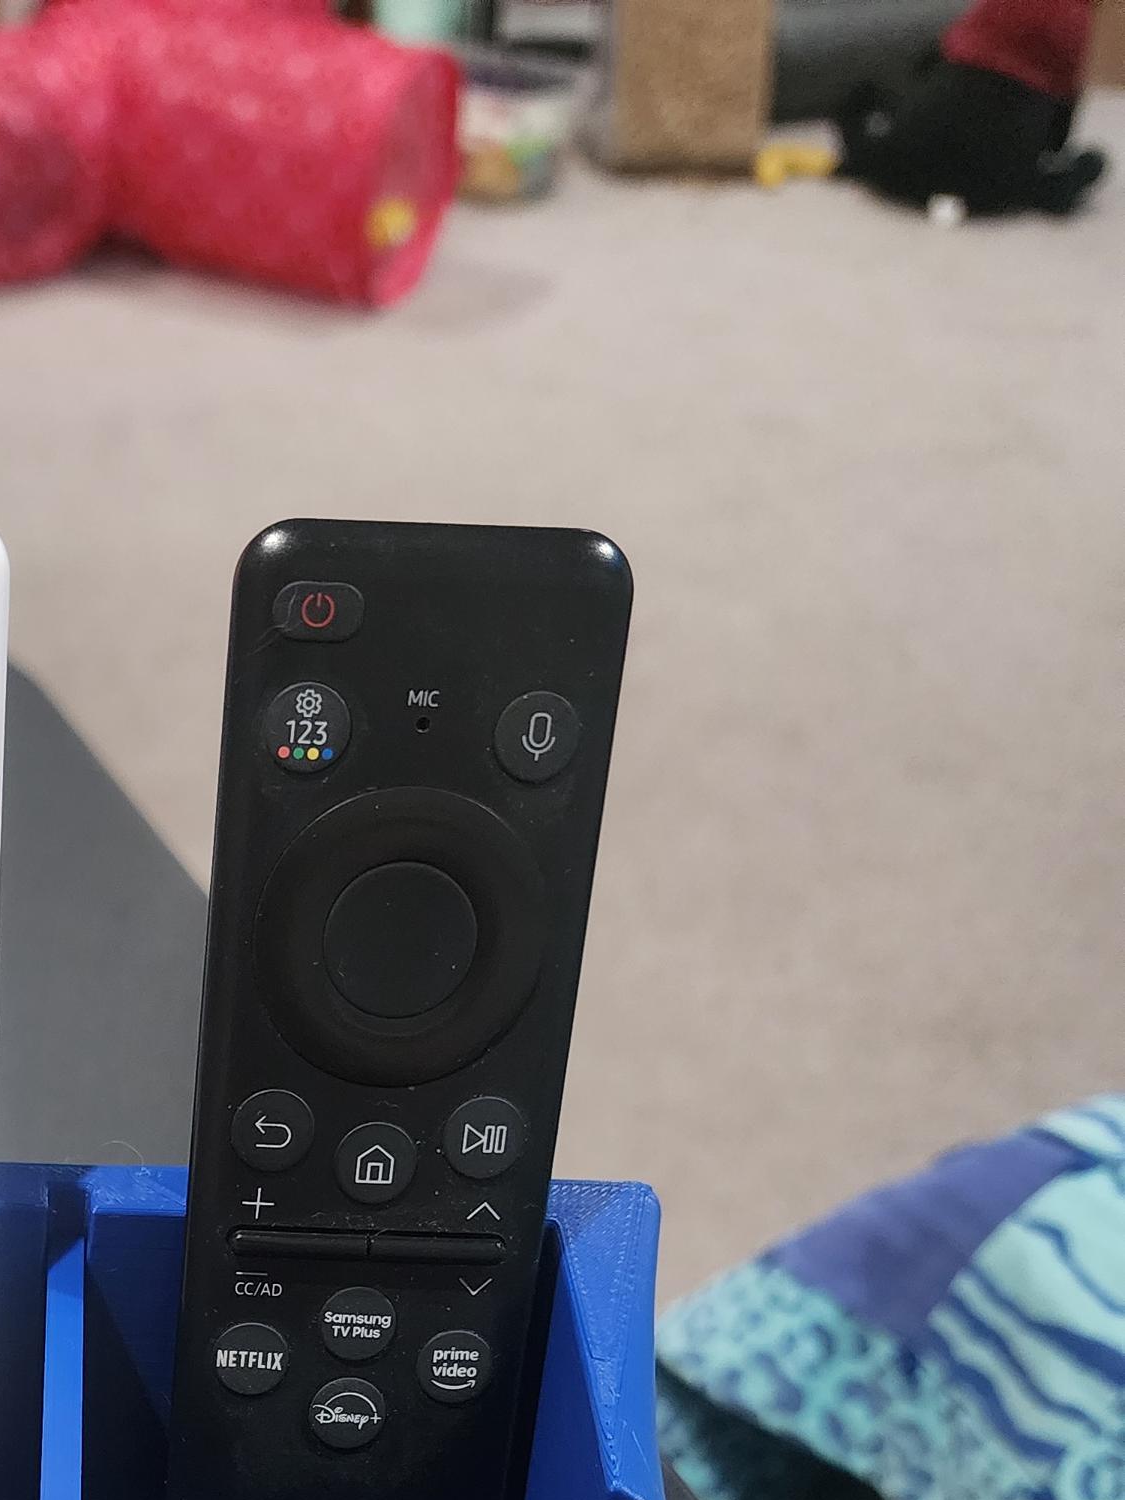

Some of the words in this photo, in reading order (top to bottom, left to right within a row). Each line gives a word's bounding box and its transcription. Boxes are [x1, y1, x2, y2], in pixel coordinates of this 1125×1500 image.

[407, 689, 440, 708] MIC
[285, 720, 328, 745] 123
[234, 1281, 283, 1297] CC/AD
[324, 1310, 392, 1328] Samsung
[332, 1325, 351, 1338] TV
[352, 1326, 381, 1339] Plus
[215, 1349, 284, 1371] NETFLIX
[432, 1346, 480, 1363] prime
[432, 1363, 477, 1379] video
